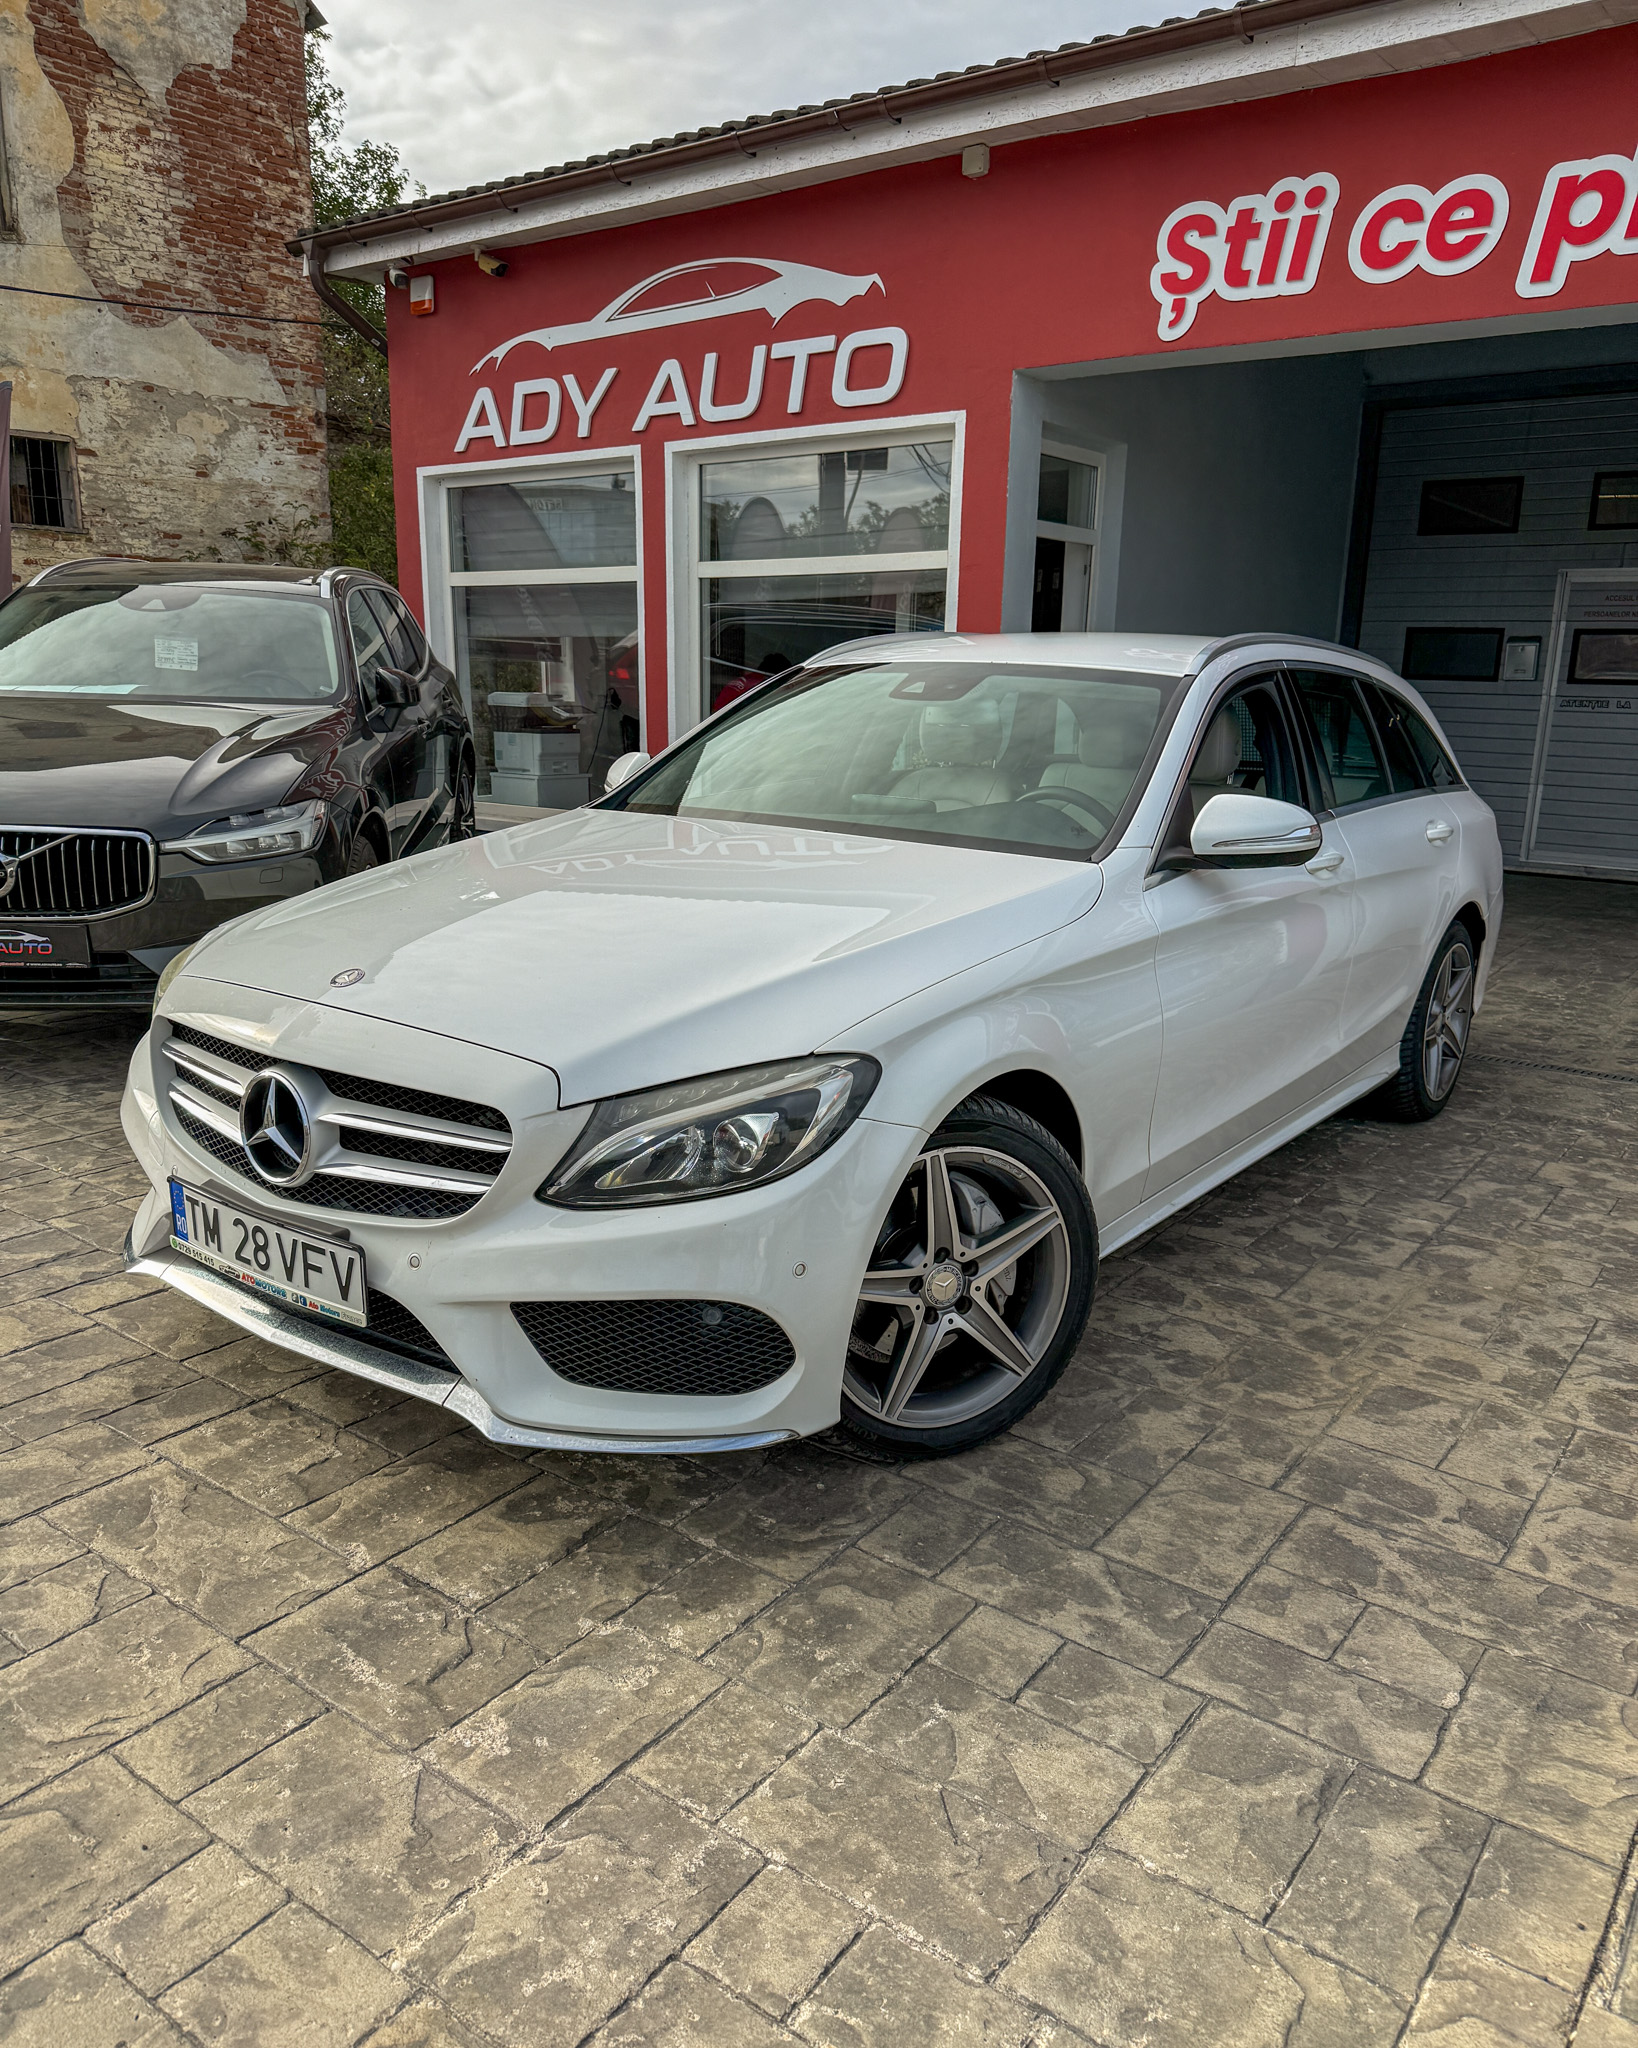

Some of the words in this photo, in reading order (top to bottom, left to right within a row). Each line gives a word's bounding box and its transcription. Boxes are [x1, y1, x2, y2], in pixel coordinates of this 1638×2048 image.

[1358, 186, 1497, 272] ce
[453, 366, 619, 453] ADY
[631, 326, 909, 433] AUTO
[1604, 594, 1634, 602] ACCESUL
[1583, 610, 1631, 618] PERSOANELOR
[1616, 700, 1632, 709] LA
[176, 1213, 188, 1234] RO
[185, 1194, 223, 1253] TM
